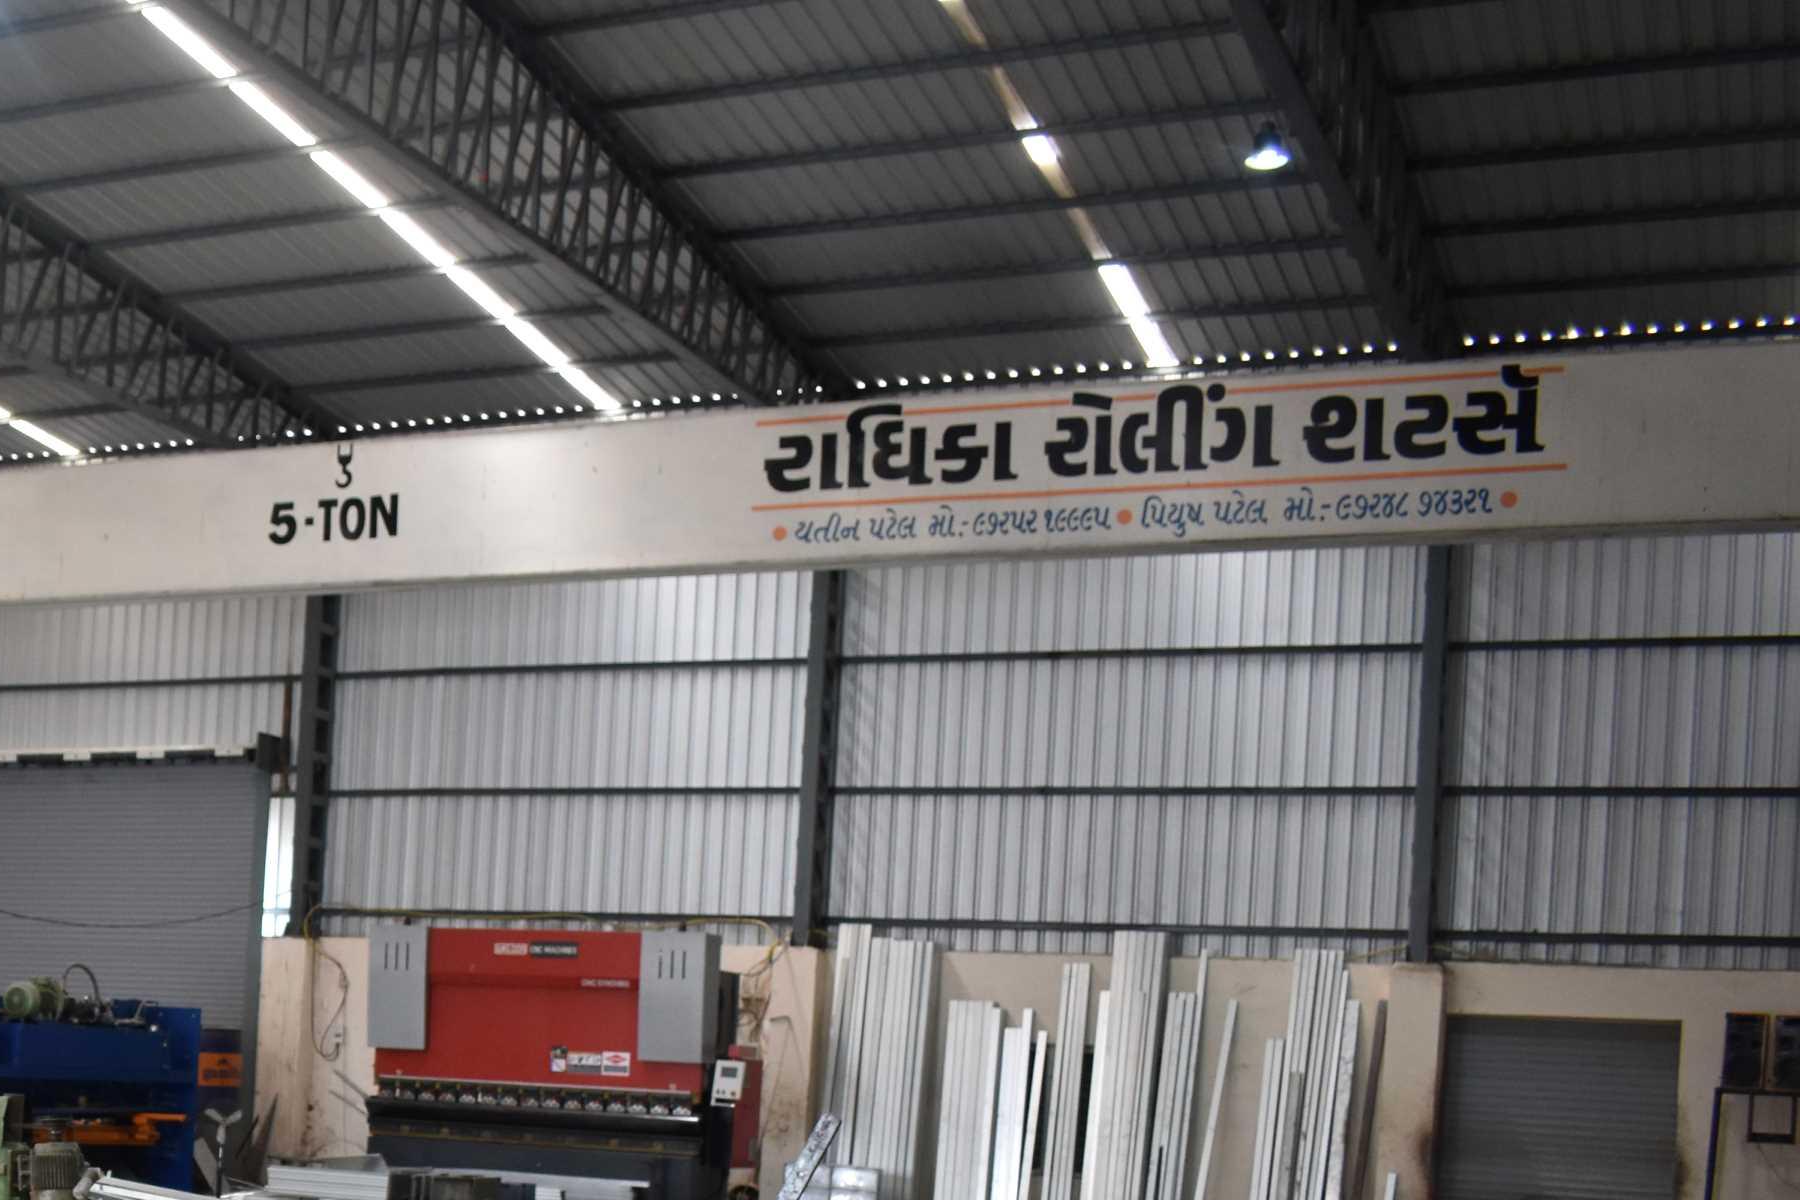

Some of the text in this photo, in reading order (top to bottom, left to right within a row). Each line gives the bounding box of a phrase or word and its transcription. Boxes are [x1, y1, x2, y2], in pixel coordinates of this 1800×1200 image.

[763, 403, 1019, 493] રાધિકા
[1044, 381, 1281, 478] રોલીંગ
[794, 511, 860, 543] યતીન
[869, 507, 918, 540] પટેલ
[1140, 494, 1205, 538] પિયુષ
[1213, 489, 1269, 525] પટેલ
